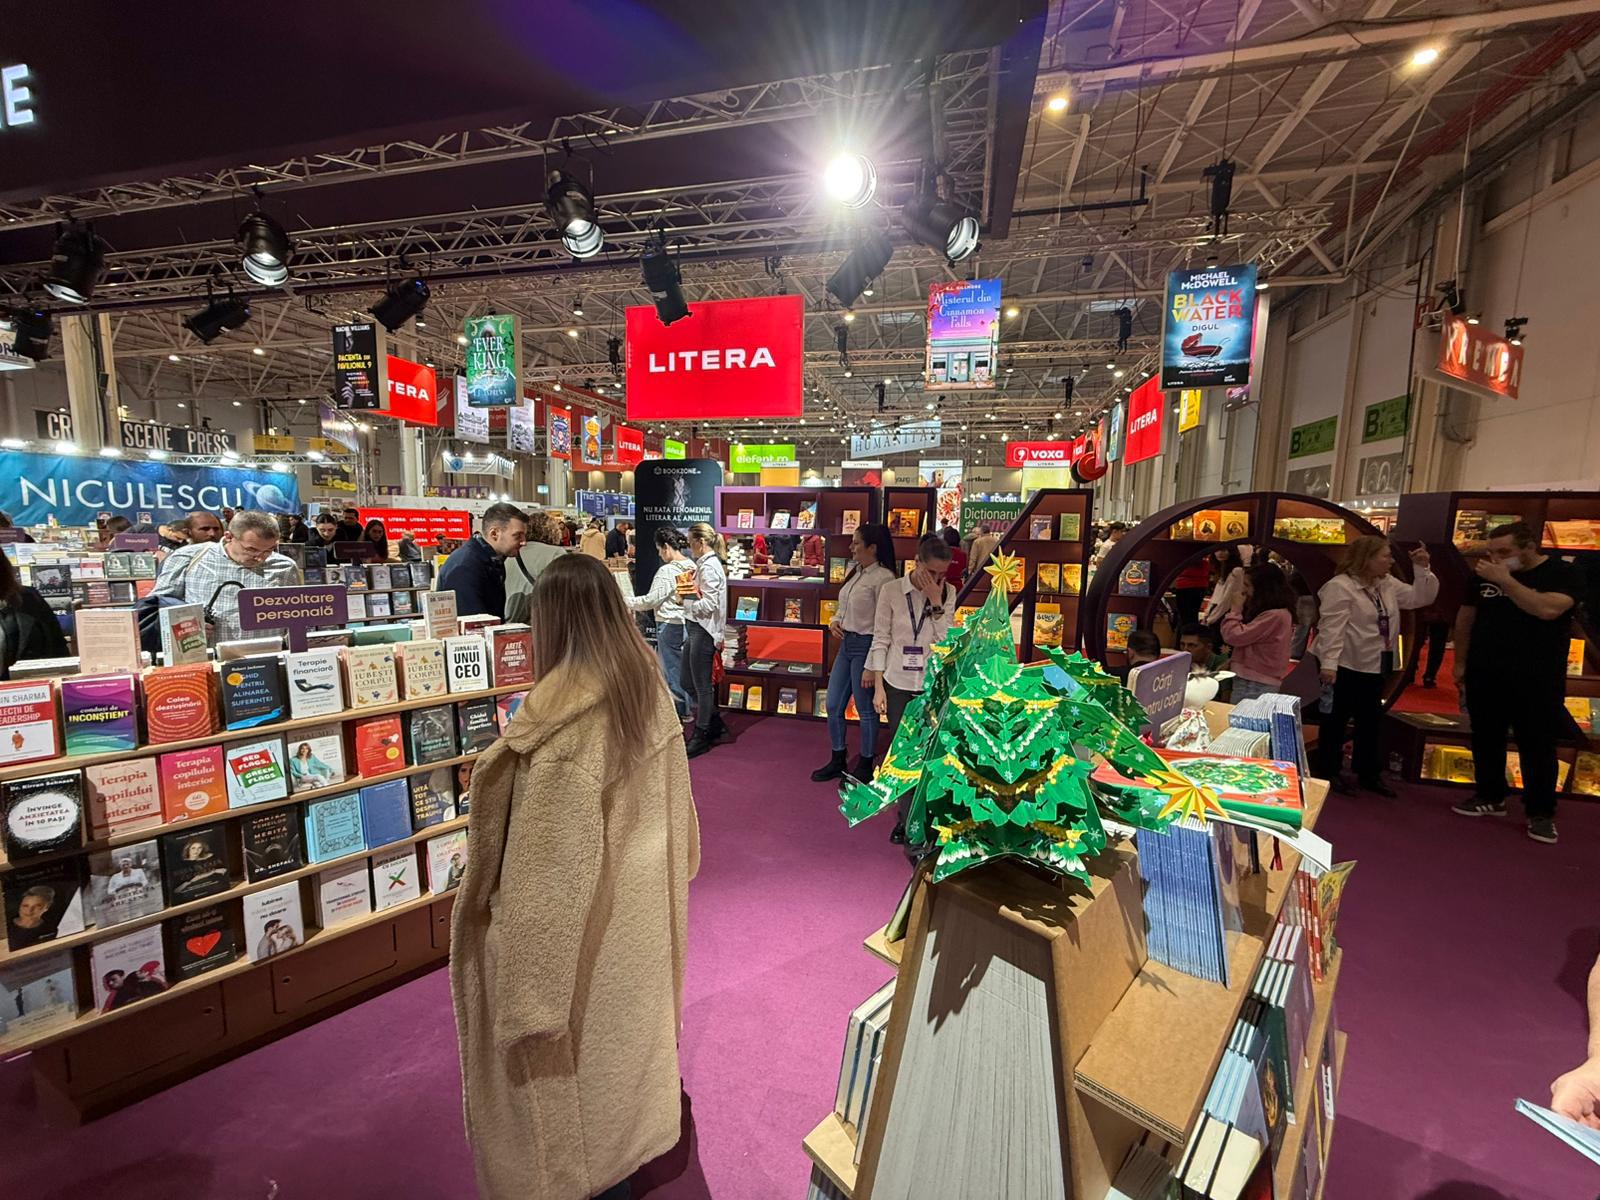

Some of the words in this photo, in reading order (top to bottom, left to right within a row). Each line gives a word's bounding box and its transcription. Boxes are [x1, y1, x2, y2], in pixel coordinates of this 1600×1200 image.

[1190, 271, 1230, 282] MICHAEL
[1181, 277, 1238, 291] McDOWELL
[934, 291, 974, 307] Misterul
[977, 290, 992, 303] din
[1174, 288, 1243, 309] BLACK
[939, 305, 985, 318] Cinnamon
[1172, 304, 1242, 323] WATER
[951, 316, 972, 328] Falls
[1192, 323, 1219, 332] DIGUL
[473, 352, 506, 370] KING
[649, 347, 776, 373] LITERA
[387, 380, 430, 400] TERA
[1130, 409, 1157, 434] LITERA
[47, 413, 73, 440] CR
[124, 422, 173, 450] SCENE
[187, 430, 230, 455] PRESS
[619, 442, 641, 452] LITERA
[855, 431, 937, 452] HUMANITAS
[1031, 450, 1064, 459] voxa
[20, 476, 242, 511] NICULESCU
[253, 593, 335, 608] Dezvoltare
[256, 605, 334, 623] personală
[298, 659, 327, 667] Terapie
[454, 651, 480, 664] UNUI
[293, 665, 333, 675] financiară
[455, 664, 480, 679] CEO
[355, 677, 393, 687] CORPUL
[1153, 671, 1173, 693] Cărți
[13, 692, 47, 703] SHARMA
[233, 688, 270, 698] ALINAREA
[231, 696, 273, 707] SUFERINȚEI
[1146, 700, 1163, 716] ntru
[25, 705, 35, 714] DE
[0, 713, 41, 724] EADERSHIP
[69, 711, 129, 723] INCONȘTIENT
[175, 756, 212, 769] Terapia
[242, 754, 260, 762] RED
[98, 770, 148, 786] Terapia
[173, 765, 215, 780] copilului
[245, 766, 275, 779] GREEN
[247, 773, 276, 784] FLAGS
[177, 776, 215, 790] interior
[96, 784, 153, 803] copilului
[414, 792, 428, 800] TOT
[27, 802, 63, 813] ÎNVINGE
[104, 801, 152, 818] interior
[18, 809, 70, 821] ANXIETATEA
[254, 826, 288, 840] MERITĂ
